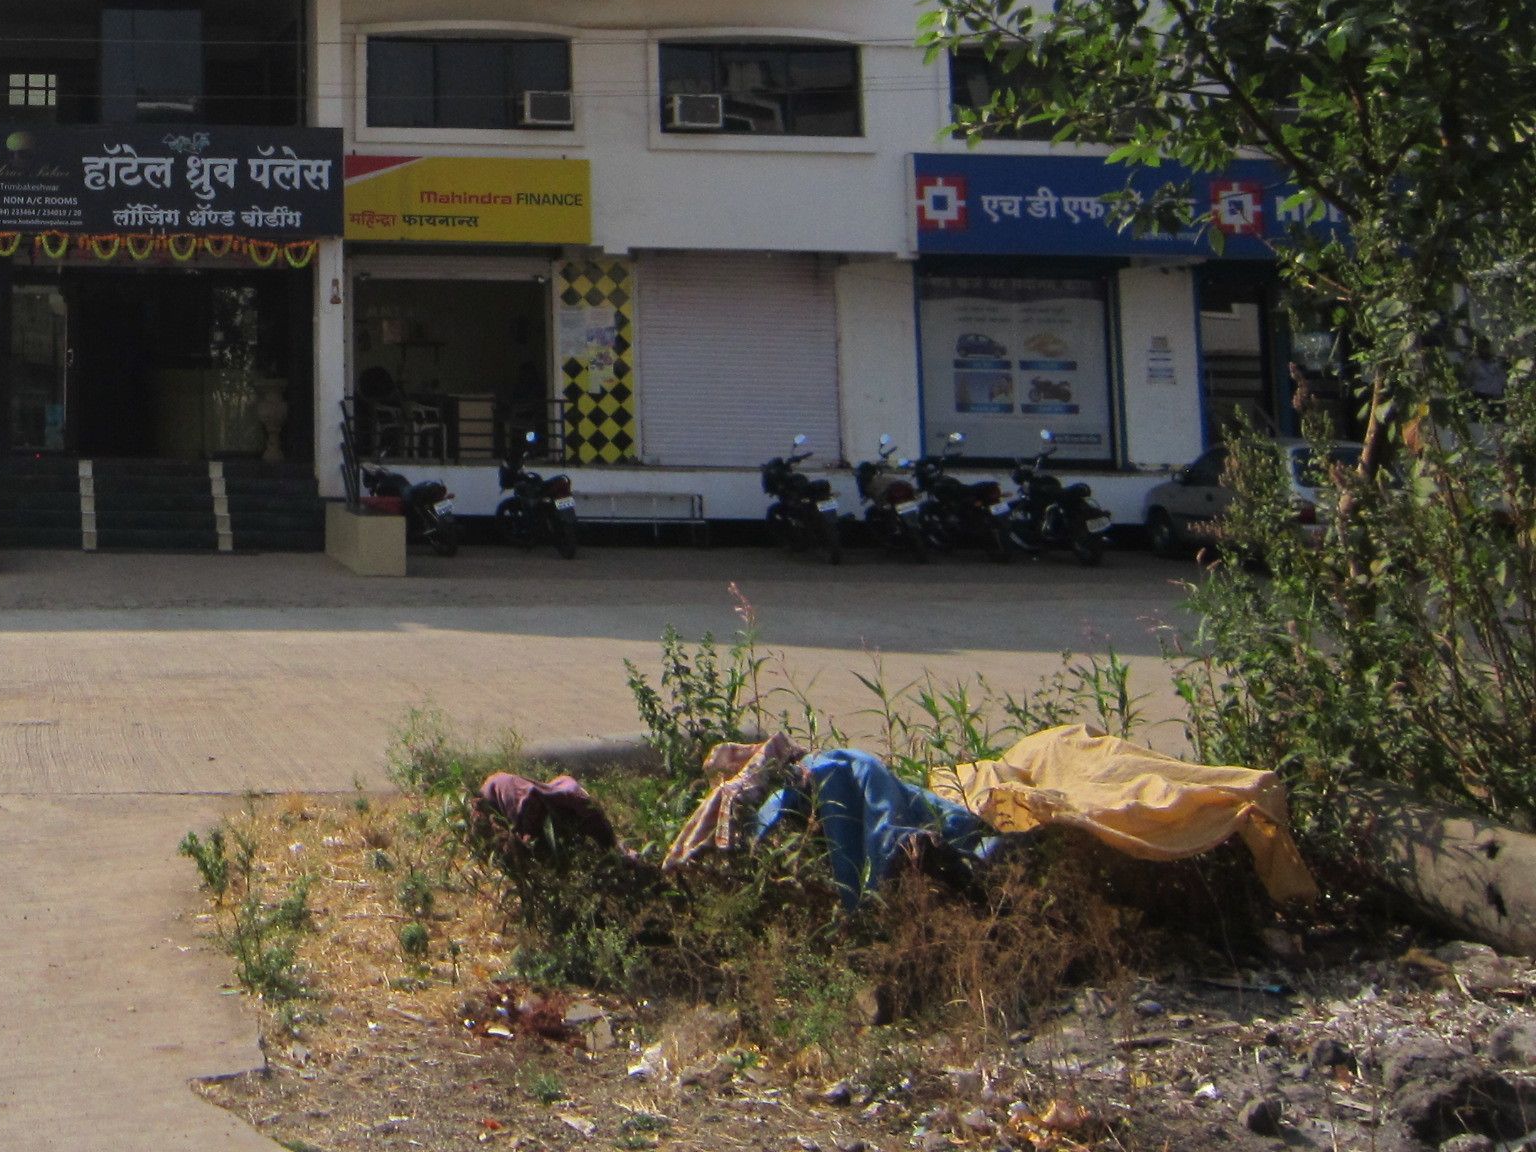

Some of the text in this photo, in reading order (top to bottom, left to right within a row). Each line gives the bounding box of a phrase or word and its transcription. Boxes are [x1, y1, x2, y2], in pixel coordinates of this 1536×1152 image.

[81, 143, 175, 190] हॉटेल
[185, 155, 238, 200] ध्रुव
[3, 196, 24, 205] NON
[26, 196, 43, 205] A/C
[44, 196, 78, 205] ROOMS
[516, 192, 583, 207] FINANCE
[981, 195, 1023, 223] एच
[1025, 186, 1058, 218] डी
[112, 203, 180, 227] लॉजिंग
